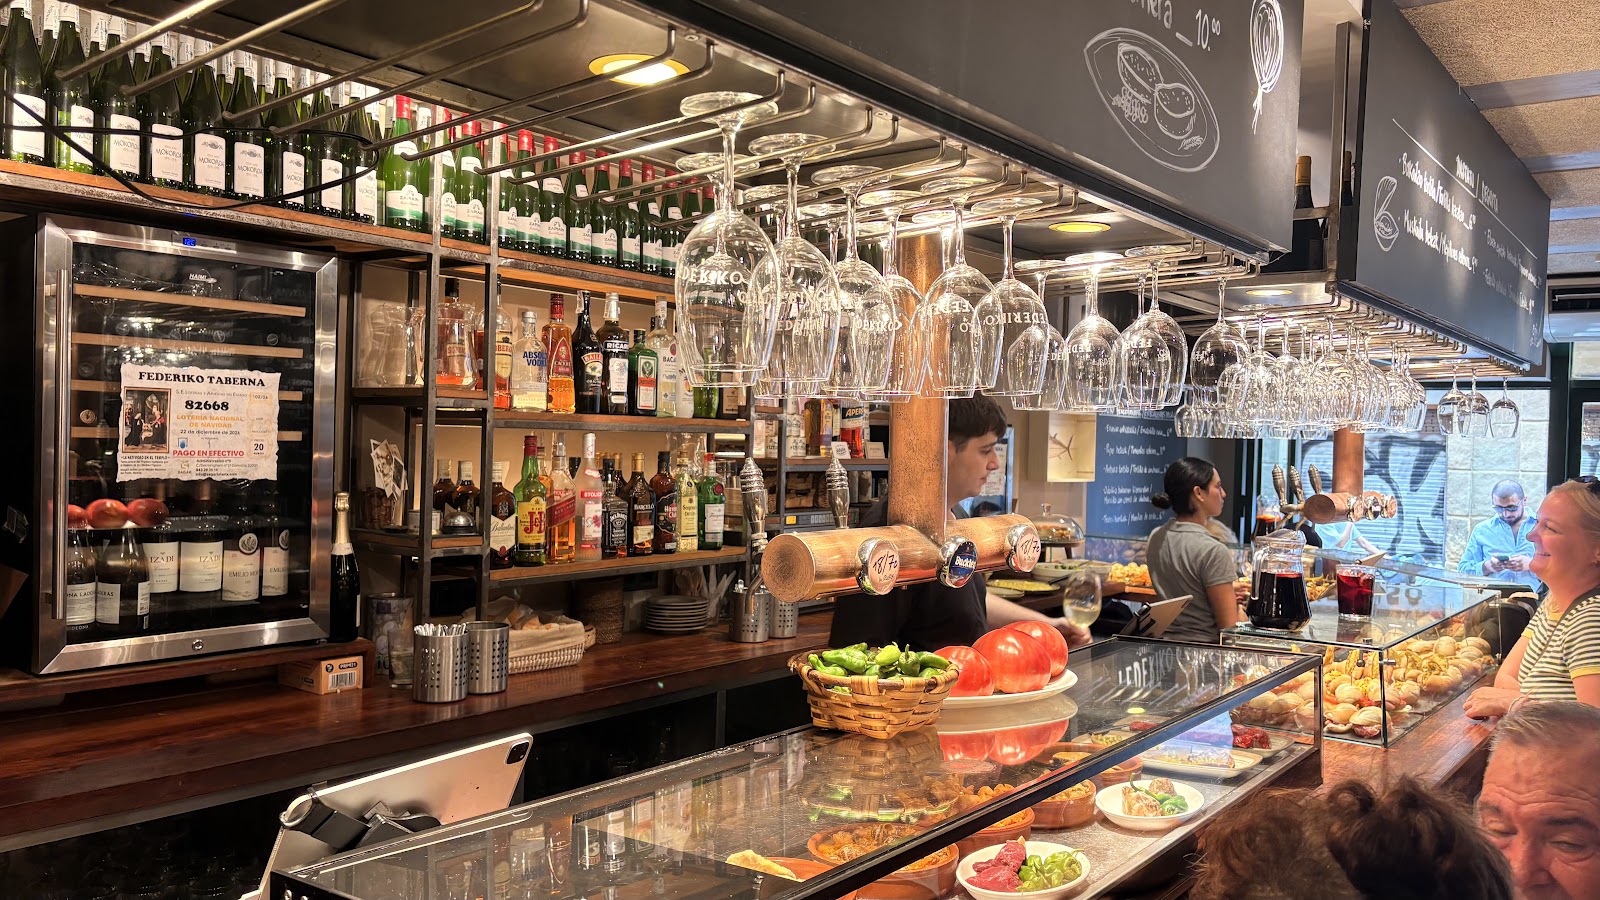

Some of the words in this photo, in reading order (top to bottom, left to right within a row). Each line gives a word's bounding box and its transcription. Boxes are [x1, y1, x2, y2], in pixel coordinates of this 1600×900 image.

[138, 371, 205, 384] FEDERIKO
[207, 375, 265, 387] TABERNA
[184, 400, 230, 411] 82668
[253, 443, 264, 451] 20
[150, 555, 174, 563] IZADI
